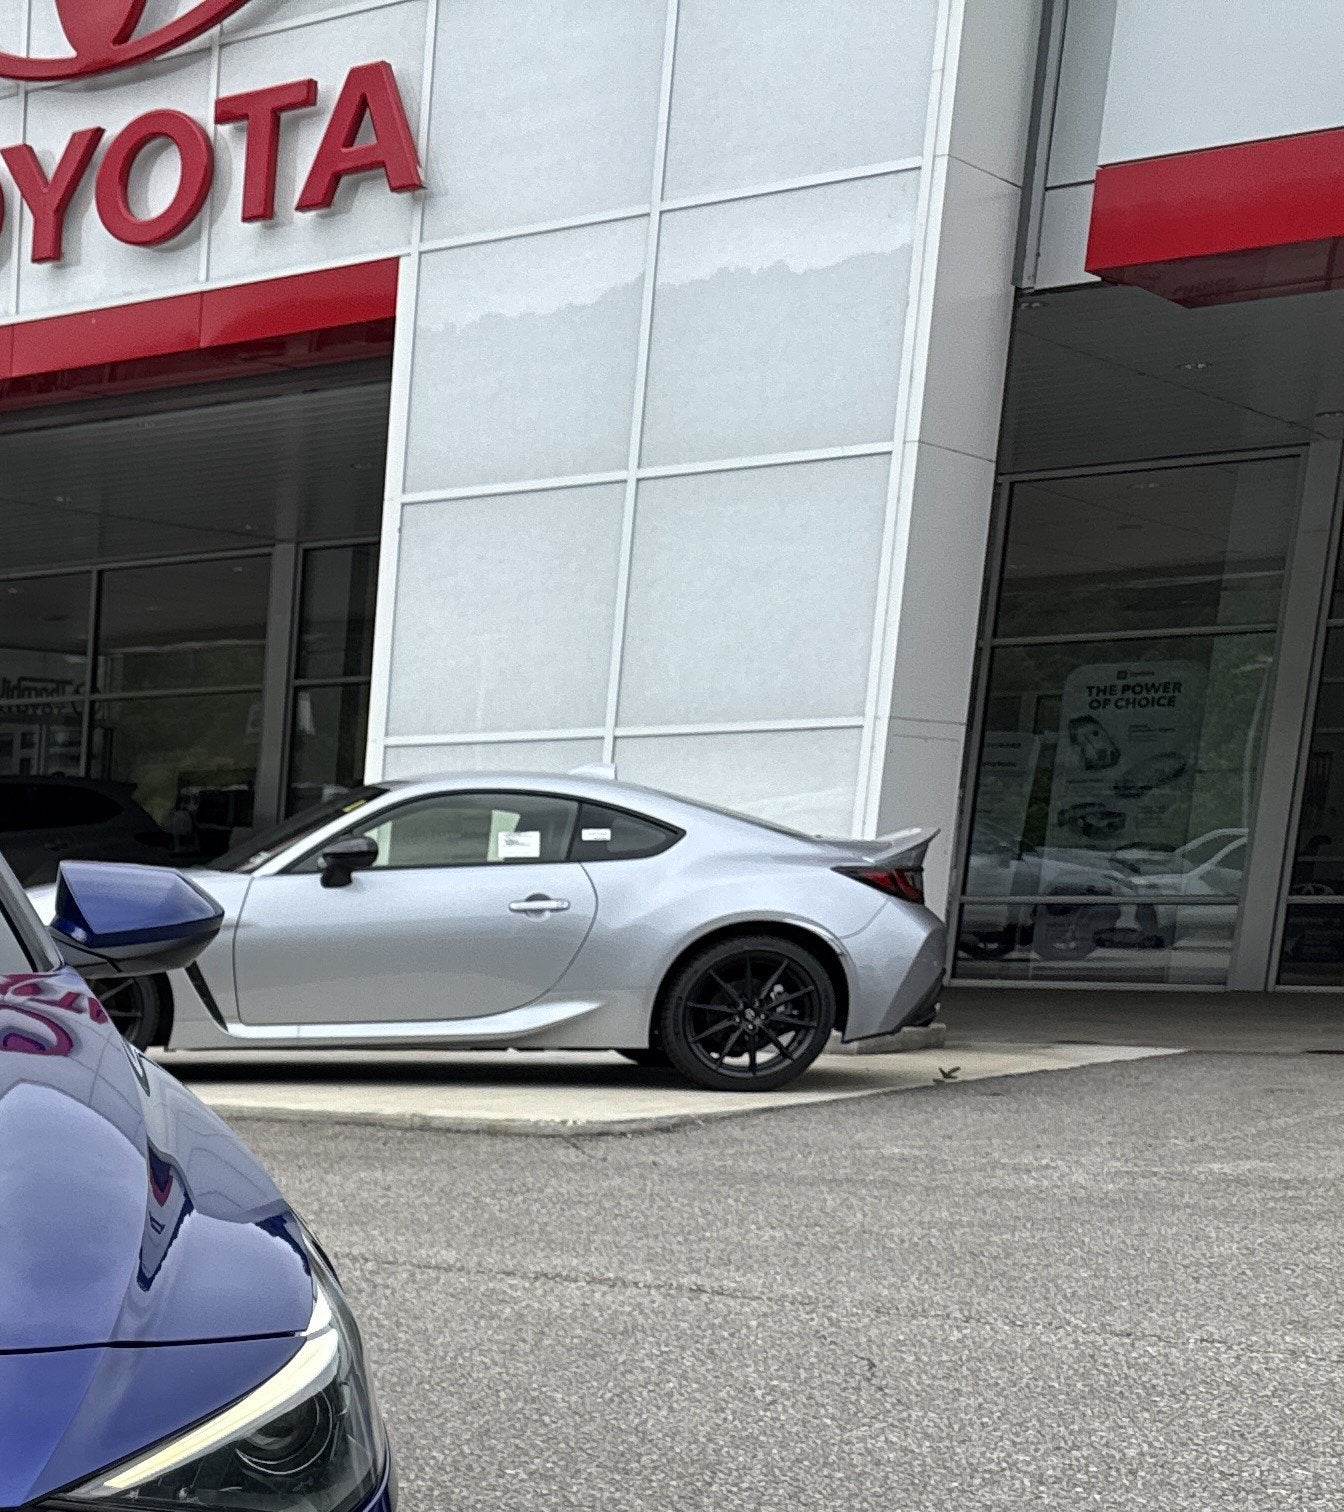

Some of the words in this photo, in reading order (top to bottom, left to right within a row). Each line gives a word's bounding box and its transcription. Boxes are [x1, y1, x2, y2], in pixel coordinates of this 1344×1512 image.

[1086, 685, 1118, 697] THE
[1121, 681, 1182, 695] POWER
[1089, 698, 1111, 710] OF
[1114, 695, 1176, 709] CHOICE
